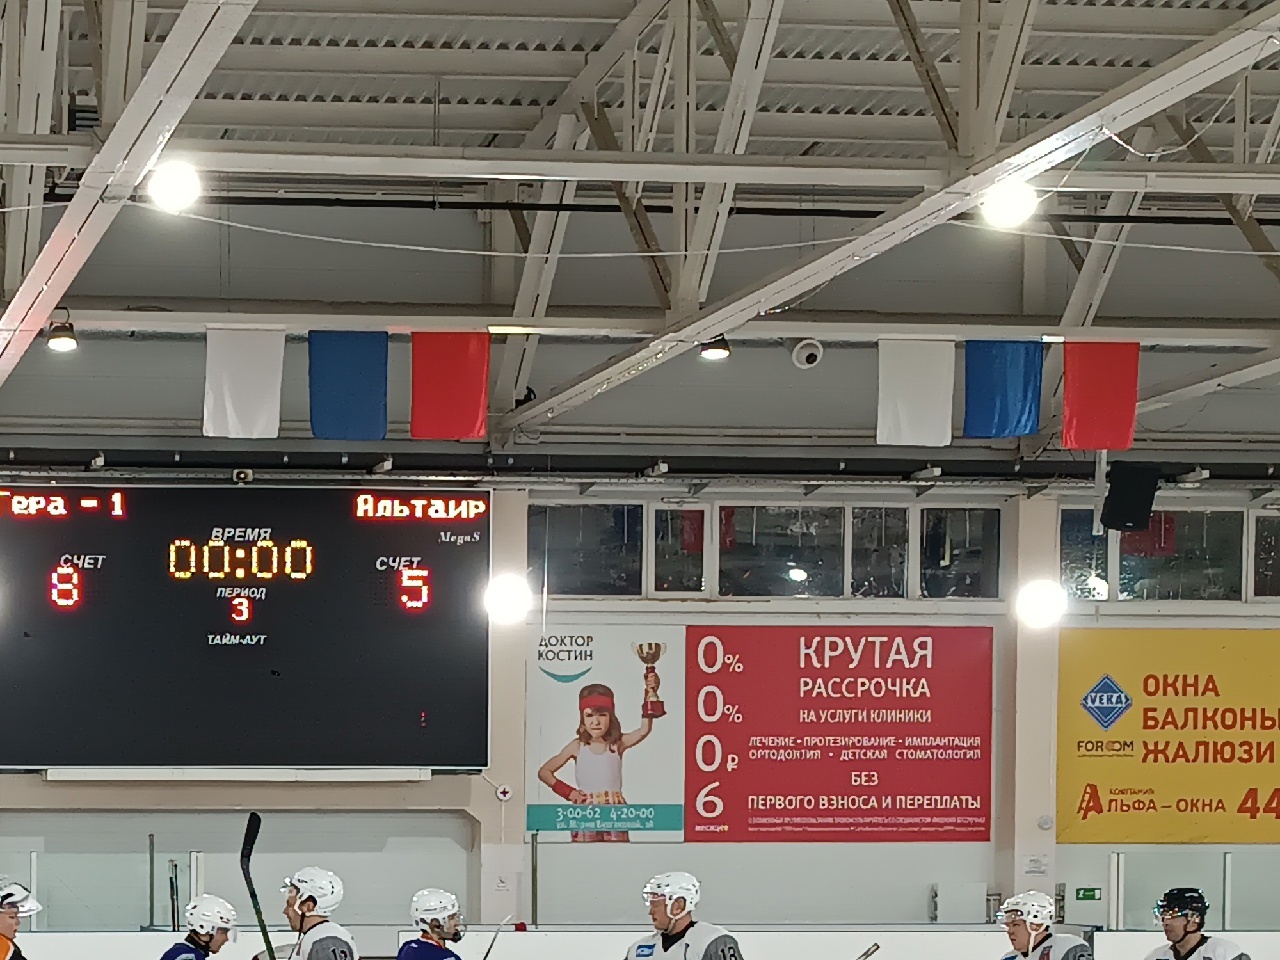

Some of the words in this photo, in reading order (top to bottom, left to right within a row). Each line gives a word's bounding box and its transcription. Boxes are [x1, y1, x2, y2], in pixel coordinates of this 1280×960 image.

[111, 493, 124, 515] 1
[356, 494, 487, 518] Альтаир
[211, 528, 271, 542] ВРЕМЯ
[60, 554, 106, 570] СЧЕТ
[169, 540, 312, 579] 00:00
[376, 556, 421, 571] СЧЕТ
[51, 567, 79, 606] 8
[216, 587, 266, 599] ПЕРИОД
[401, 569, 428, 608] 5
[232, 598, 249, 621] 3
[539, 636, 594, 649] ДОКТОР
[537, 648, 594, 662] КОСТИН
[799, 636, 933, 669] КРУТАЯ
[799, 677, 931, 697] РАССРОЧКА
[1143, 674, 1220, 697] ОКНА
[1089, 694, 1124, 705] VEKA
[800, 710, 816, 722] НА
[819, 709, 867, 723] УСЛУГИ
[869, 709, 932, 723] КЛИНИКИ
[749, 736, 795, 747] ЛЕЧЕНИЕ
[804, 736, 897, 747] ПРОТЕЗИРОВАНИЕ
[905, 736, 981, 747] ИМПЛАНТАЦИЯ
[749, 750, 821, 760] ОРТОДОНТИЯ
[839, 750, 888, 761] ДЕТСКАЯ
[895, 750, 981, 760] СТОМАТОЛОГИЯ
[1142, 741, 1275, 763] ЖАЛЮЗИ
[852, 772, 879, 786] БЕЗ
[696, 782, 724, 818] 6
[748, 796, 815, 810] ПЕРВОГО
[819, 796, 878, 810] ВЗНОСА
[882, 796, 891, 810] И
[896, 796, 981, 810] ПЕРЕПЛАТЫ
[1176, 798, 1226, 813] ОКНА
[556, 806, 601, 821] 3-00-62
